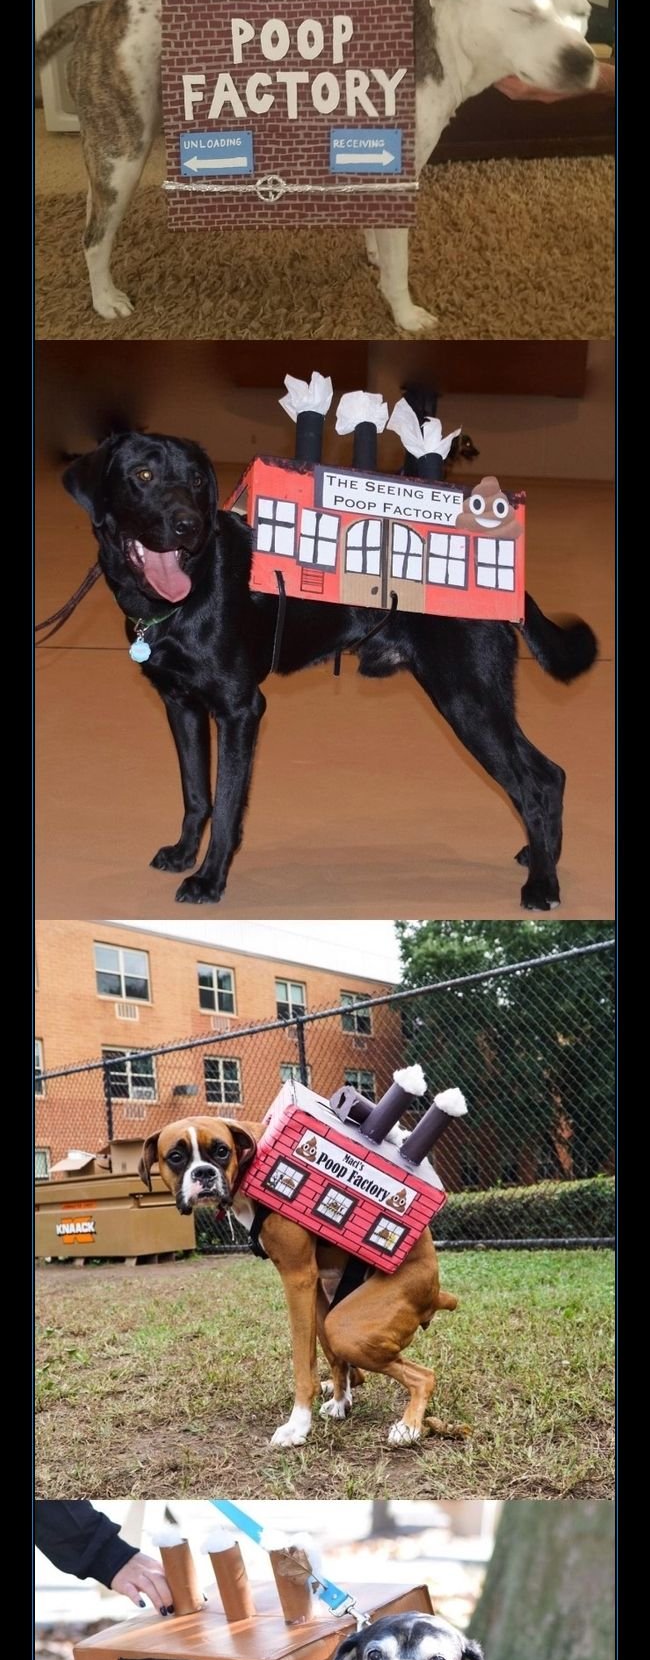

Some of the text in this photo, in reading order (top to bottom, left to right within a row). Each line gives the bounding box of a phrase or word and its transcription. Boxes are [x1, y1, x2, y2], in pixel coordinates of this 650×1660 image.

[231, 15, 354, 64] POOP
[182, 68, 408, 121] FACTORY
[183, 138, 242, 150] UNLOADING
[333, 139, 385, 148] RECEIVING
[326, 474, 461, 505] THE SEEING EYE
[334, 495, 453, 522] POOP FACTORY
[316, 1152, 390, 1202] Poop Factory
[56, 1221, 96, 1235] KNAACK
